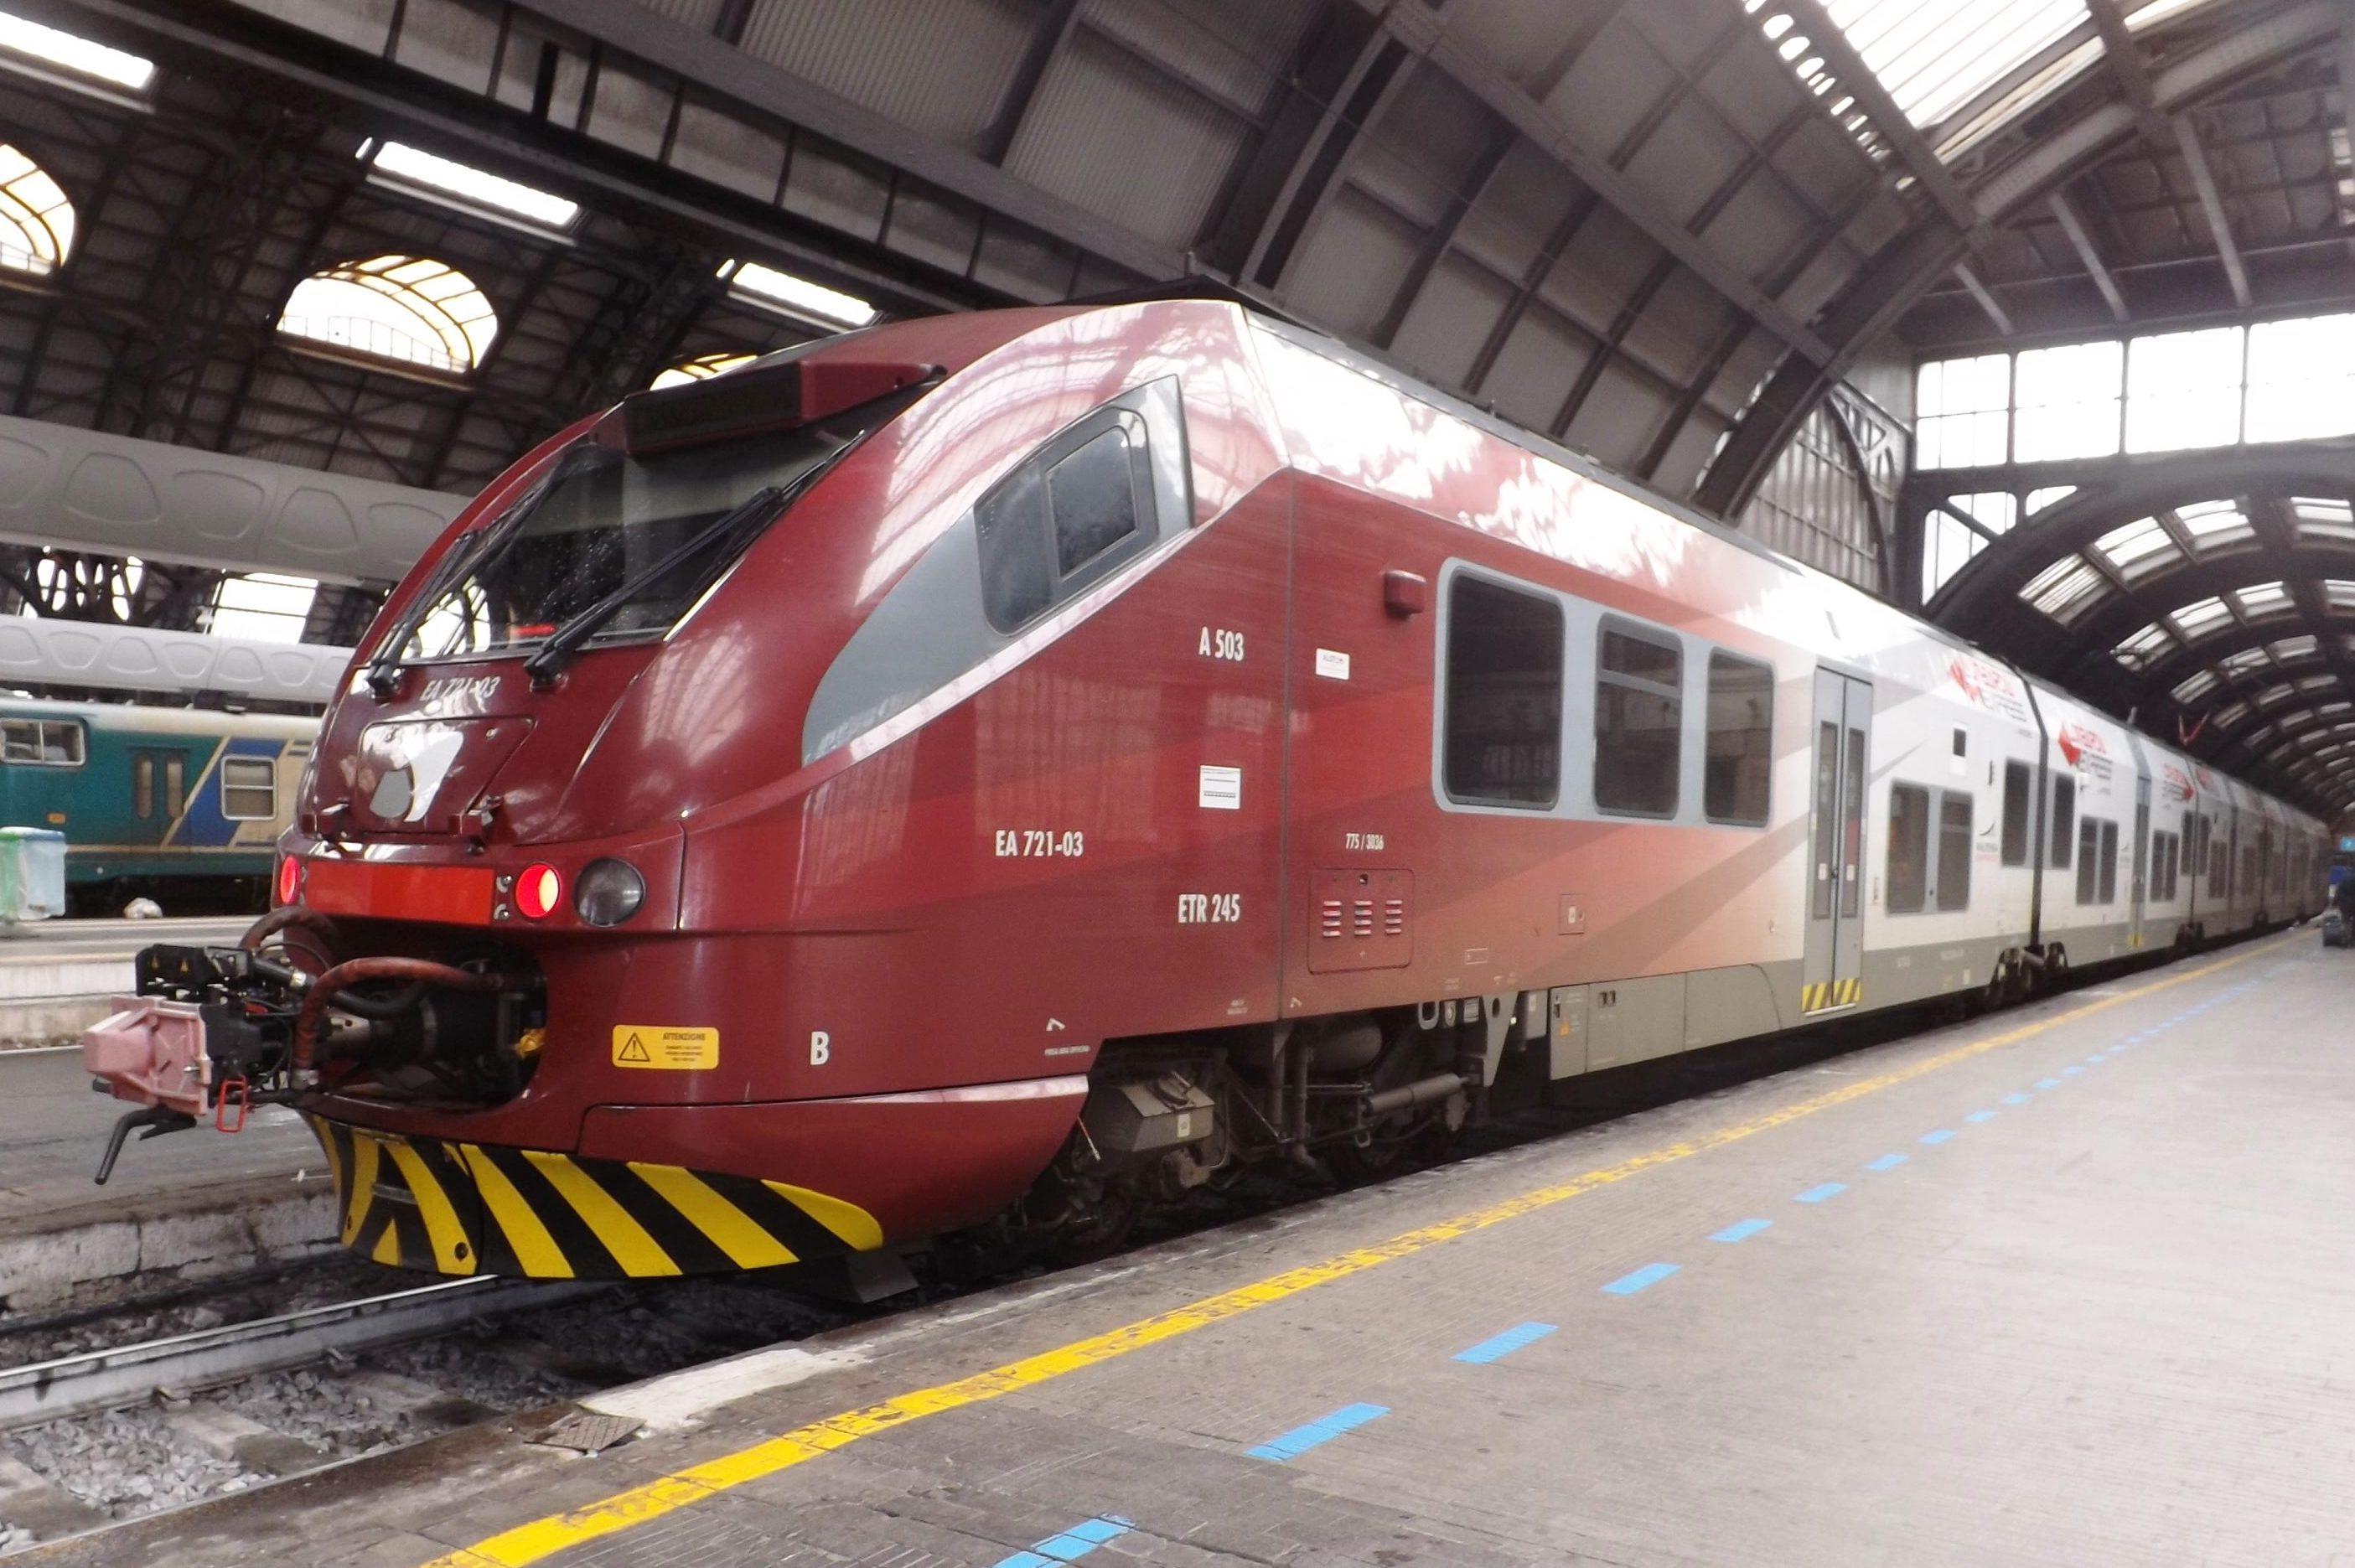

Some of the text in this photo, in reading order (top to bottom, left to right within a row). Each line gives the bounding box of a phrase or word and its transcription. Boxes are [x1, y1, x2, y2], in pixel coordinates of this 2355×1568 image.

[1198, 626, 1244, 661] A 503
[995, 830, 1084, 856] EA 721-03
[1345, 833, 1359, 849] 775
[1178, 893, 1240, 923] ETR 245
[810, 1031, 829, 1065] B
